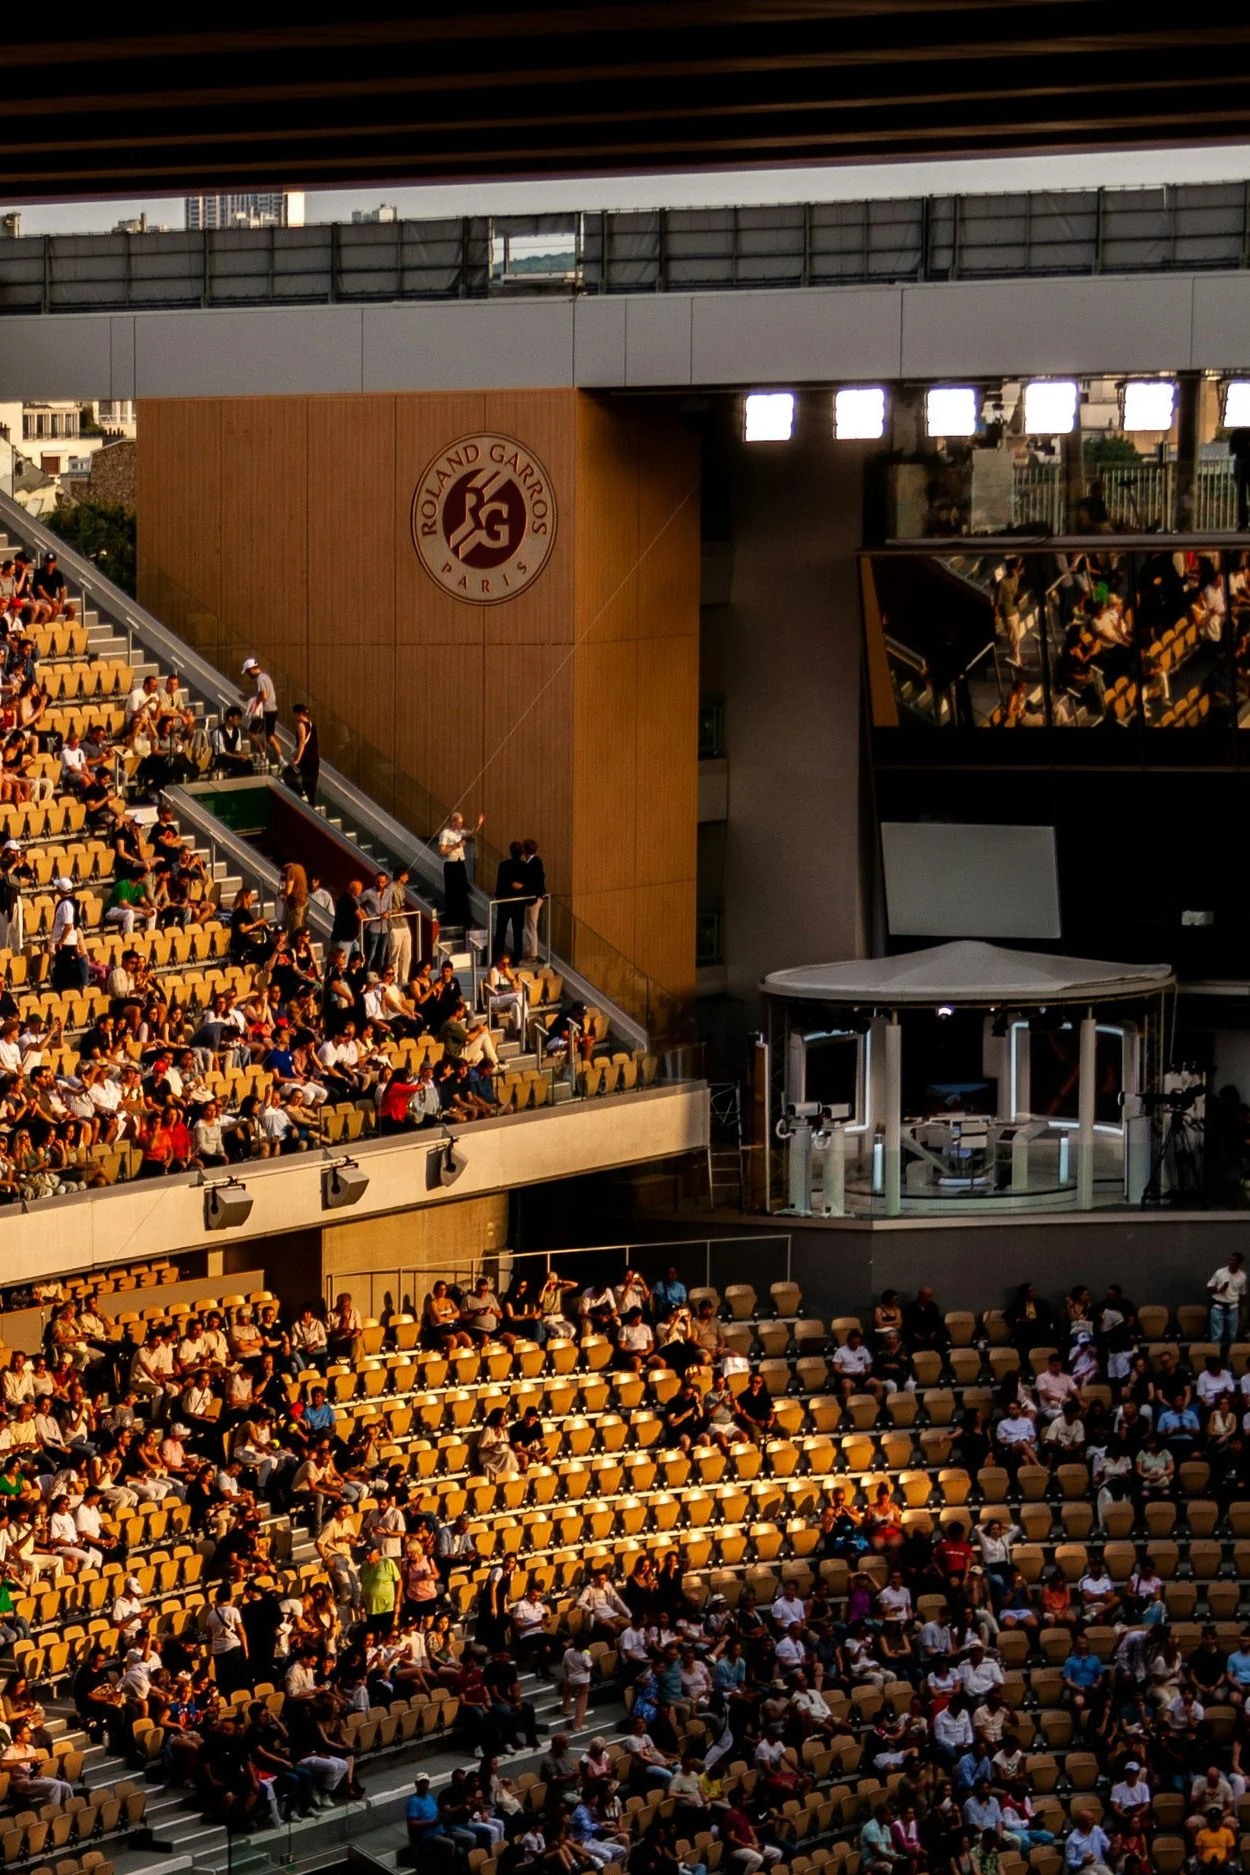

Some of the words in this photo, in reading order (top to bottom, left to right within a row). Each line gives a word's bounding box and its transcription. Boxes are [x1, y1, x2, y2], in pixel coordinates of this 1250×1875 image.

[421, 444, 480, 536] ROLAND
[489, 444, 548, 536] GARROS
[441, 562, 527, 592] PARIS
